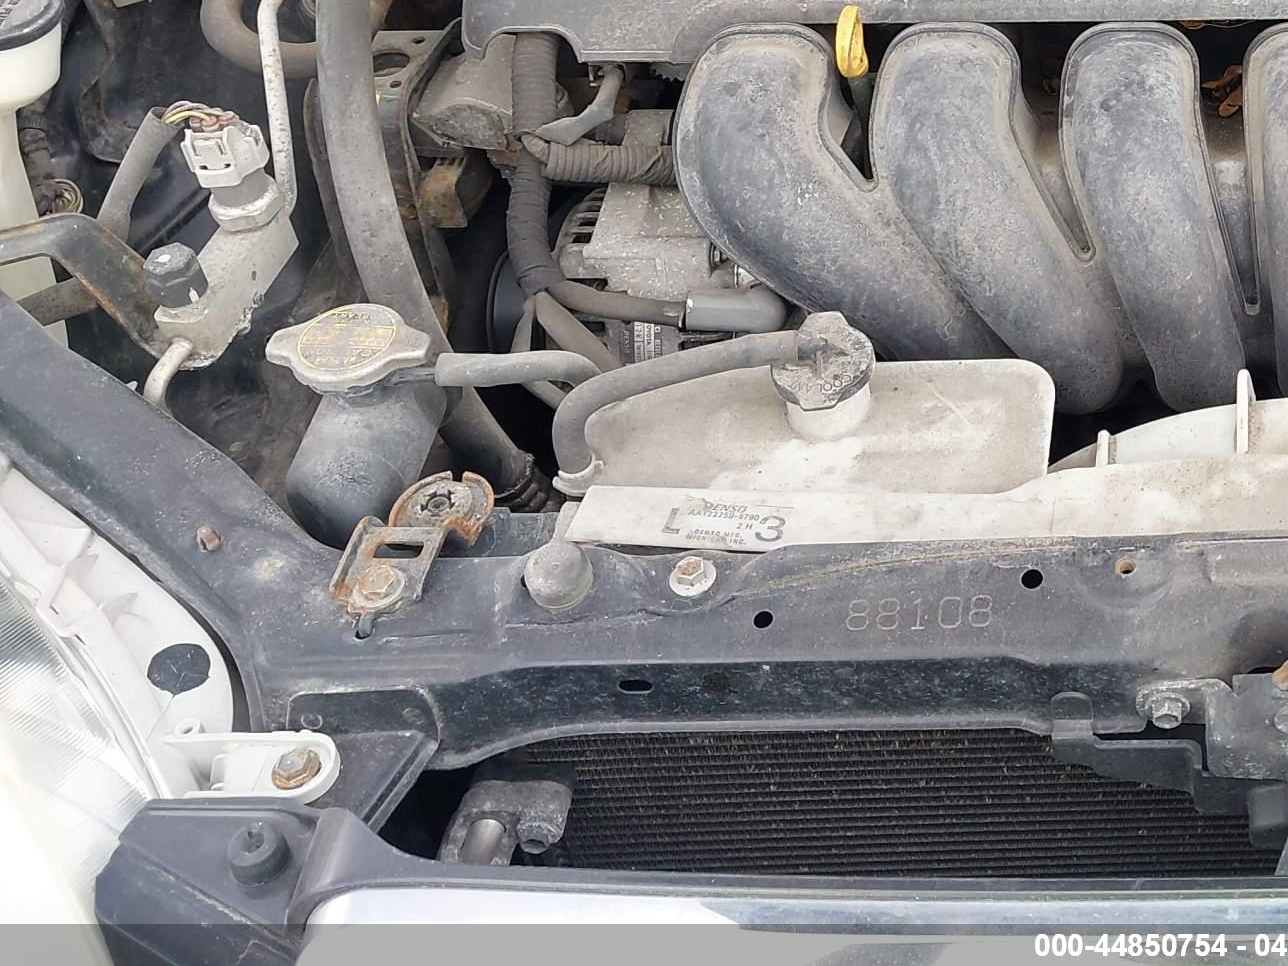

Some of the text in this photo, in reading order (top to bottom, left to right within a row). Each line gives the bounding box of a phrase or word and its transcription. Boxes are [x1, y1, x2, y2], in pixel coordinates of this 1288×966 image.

[703, 500, 748, 513] DENSO
[745, 522, 753, 530] H
[754, 515, 786, 542] 3
[845, 594, 993, 631] 88108
